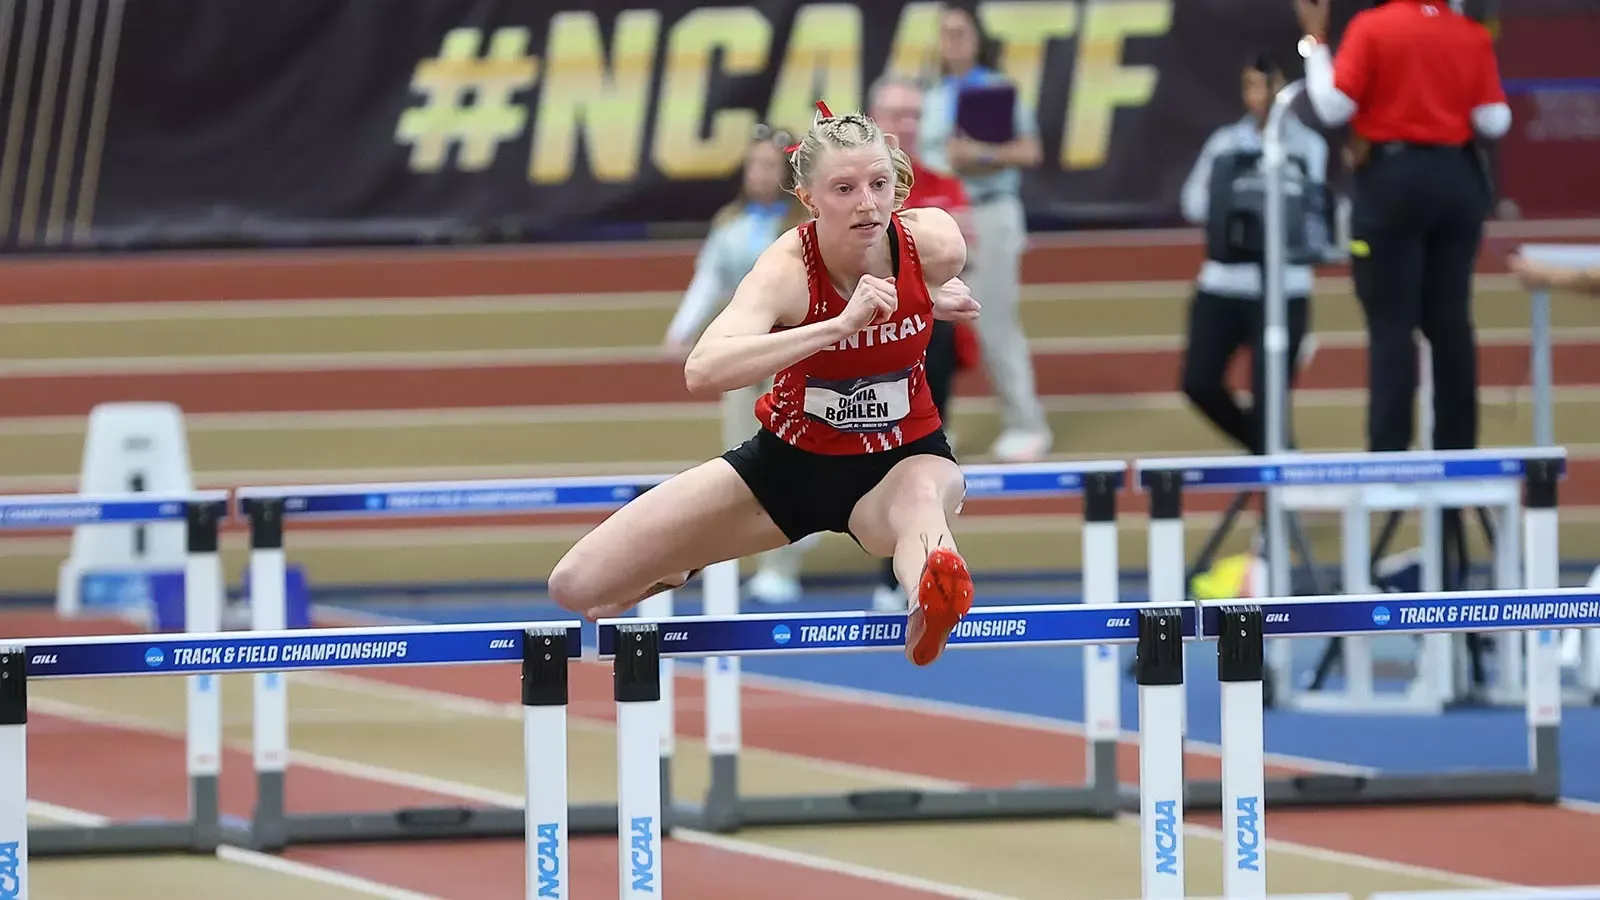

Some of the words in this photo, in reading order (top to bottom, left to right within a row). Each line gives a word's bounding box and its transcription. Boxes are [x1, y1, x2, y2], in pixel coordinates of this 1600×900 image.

[821, 314, 927, 351] NTRAL
[825, 402, 889, 422] BOHLEN
[1106, 618, 1131, 628] GILL
[1265, 613, 1290, 623] GILL
[1400, 607, 1445, 624] TRACK
[1447, 606, 1458, 623] &
[1460, 605, 1499, 622] FIELD
[1502, 601, 1600, 620] CHAMPIONSH
[490, 639, 515, 649] GILL
[664, 631, 689, 641] GILL
[800, 625, 849, 642] TRACK
[849, 624, 860, 641] &
[862, 623, 901, 641] FIELD
[32, 654, 58, 664] GILL
[173, 647, 221, 665] TRACK
[223, 647, 236, 664] &
[237, 645, 279, 663] FIELD
[281, 640, 408, 662] CHAMPIONSHIPS
[1155, 800, 1177, 876] NCAA
[1236, 796, 1259, 872] NCAA
[537, 823, 560, 899] NCAA
[631, 816, 654, 893] NCAA
[0, 841, 19, 900] CAA
